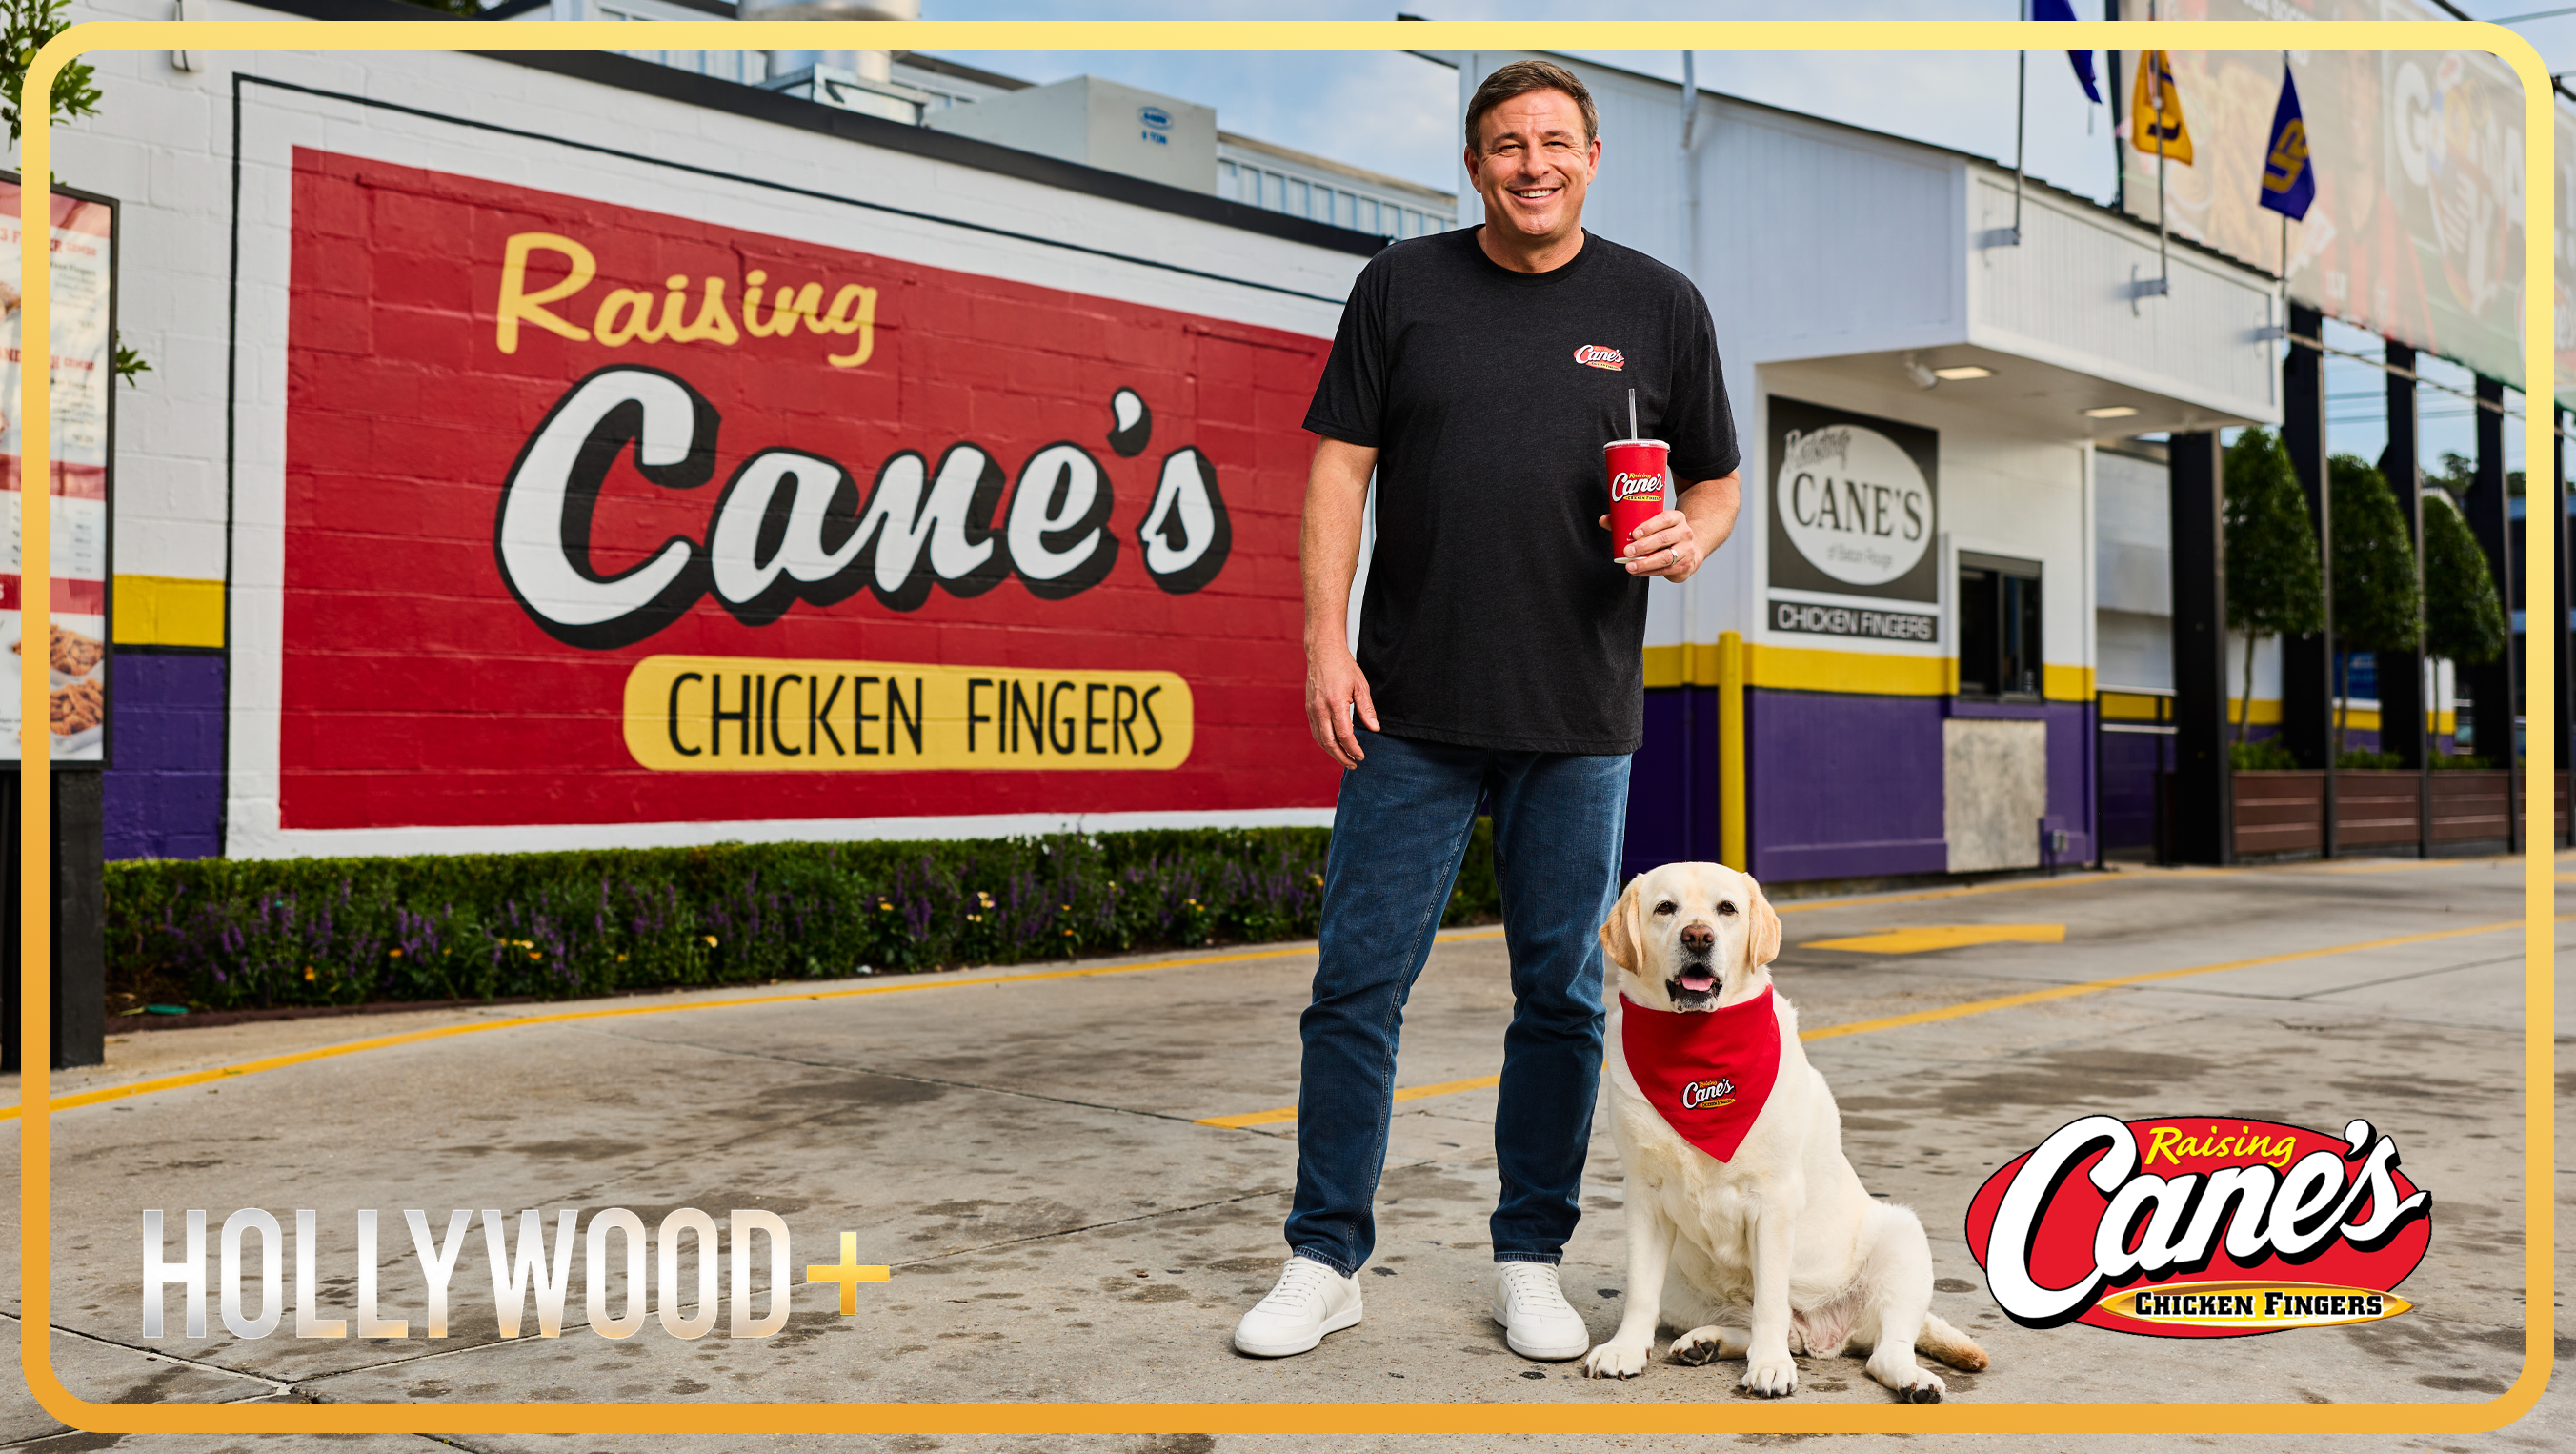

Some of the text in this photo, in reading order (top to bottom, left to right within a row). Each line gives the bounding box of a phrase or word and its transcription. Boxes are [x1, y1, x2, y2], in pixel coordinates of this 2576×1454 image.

[496, 232, 878, 368] Raising
[1575, 344, 1625, 364] Cane's
[494, 364, 1231, 650] Cane's
[1611, 472, 1664, 503] Cane's
[1792, 472, 1922, 543] CANE'S
[1777, 603, 1933, 641] CHICKEN FINGERS
[667, 672, 1164, 757] CHICKEN FINGERS
[1682, 1078, 1735, 1110] Cane's
